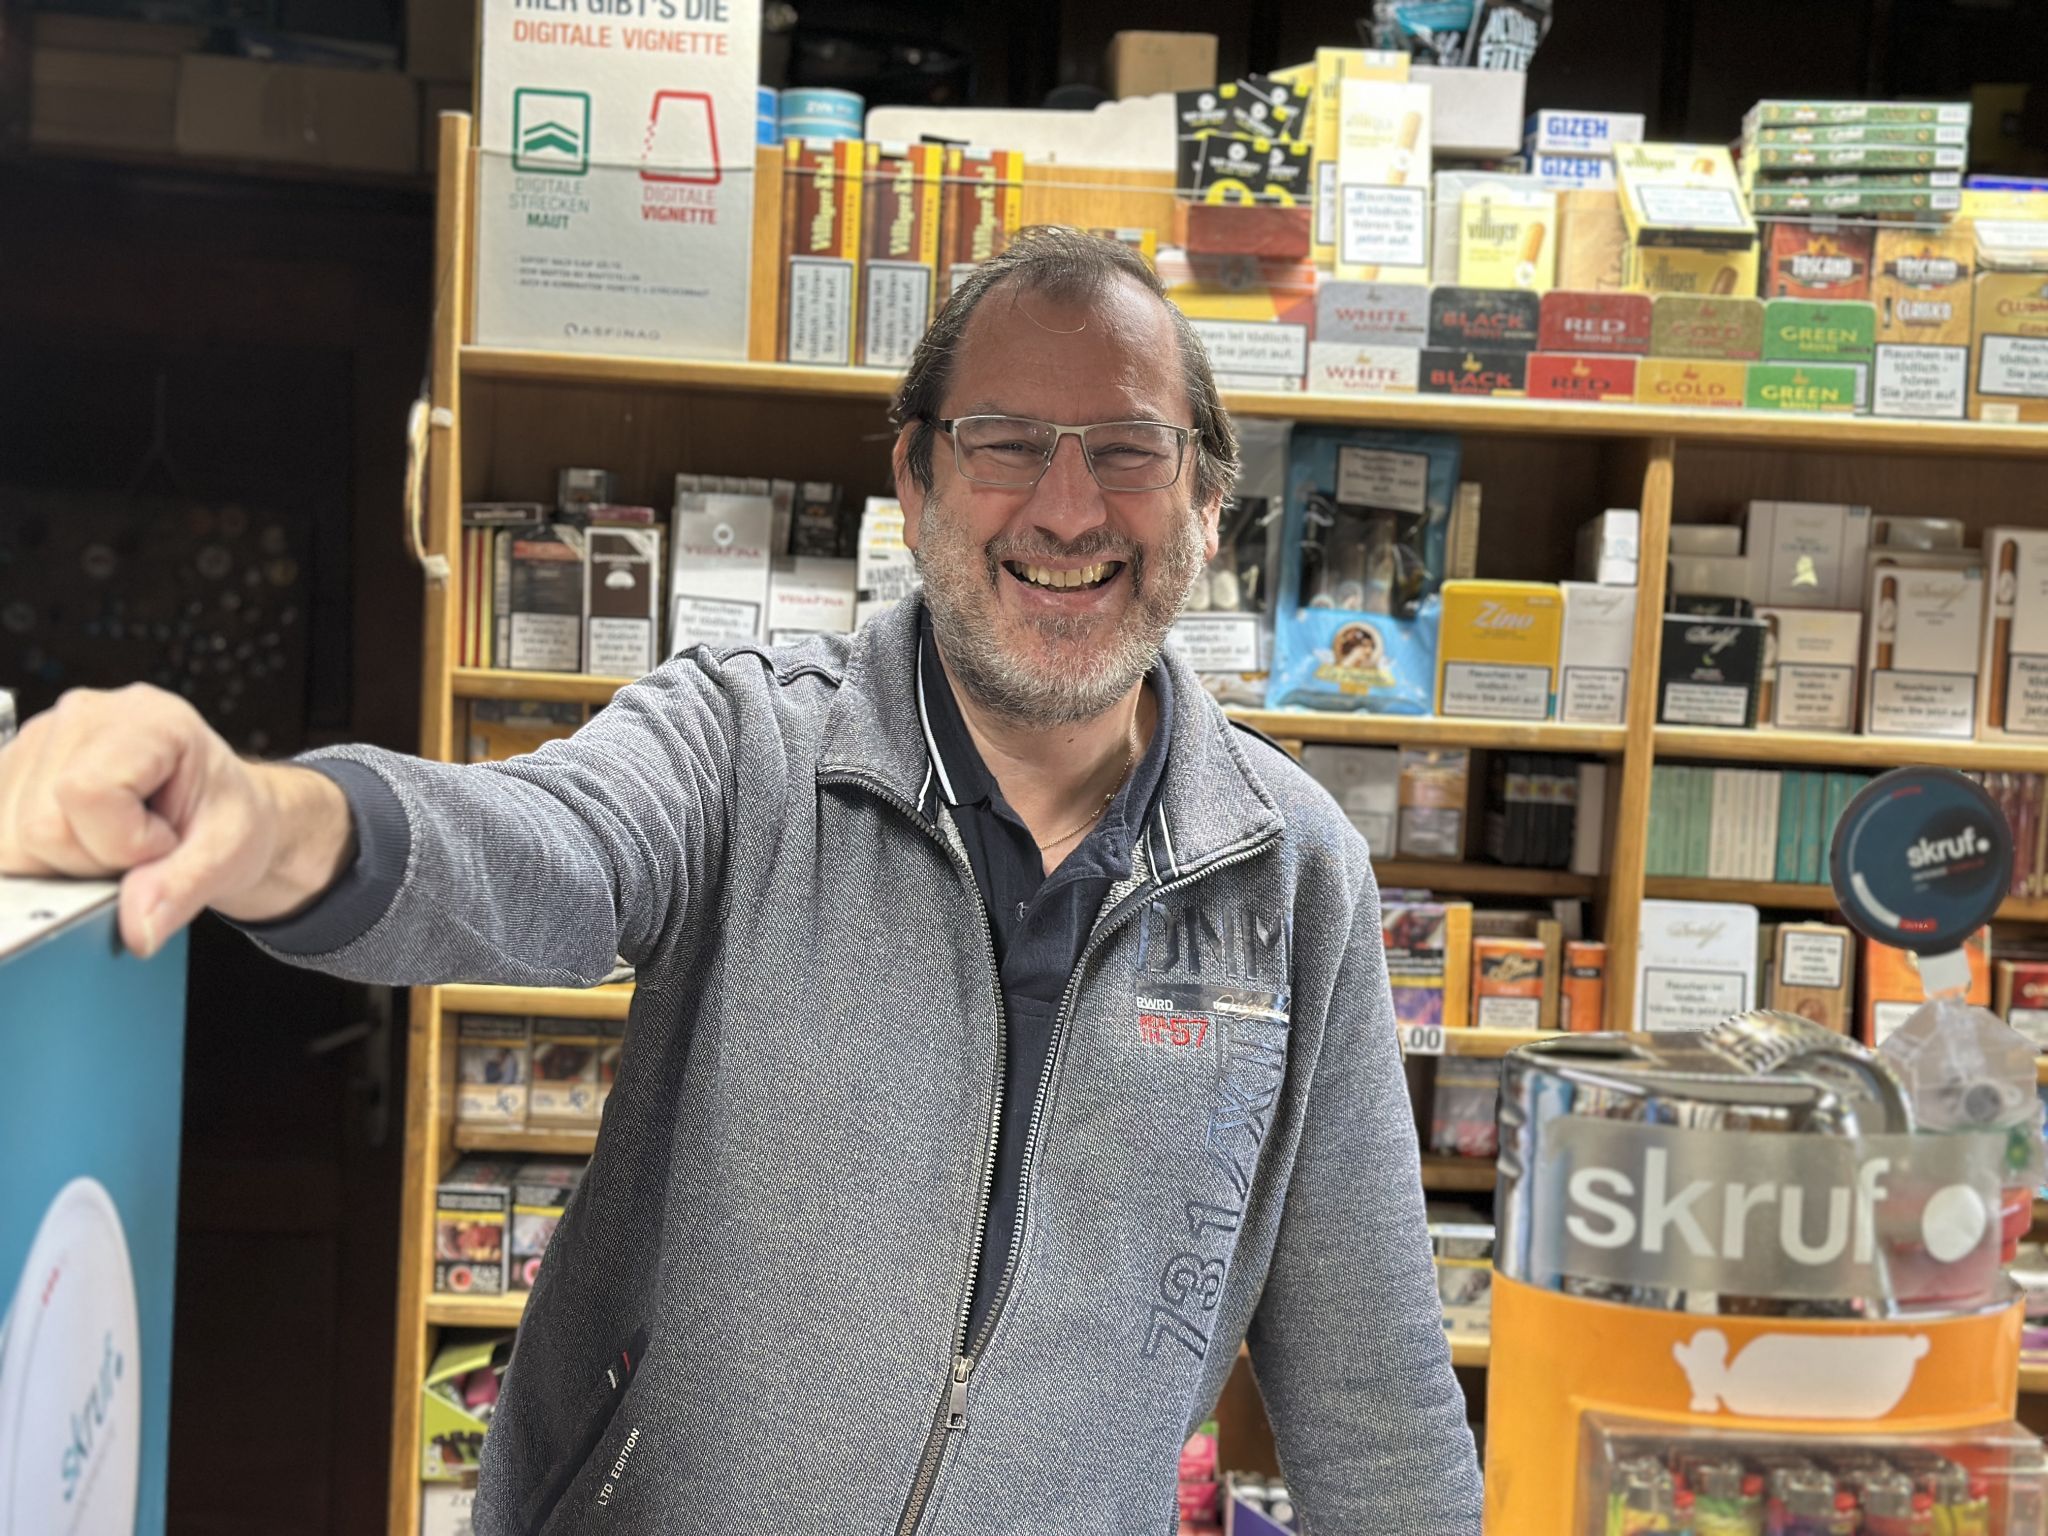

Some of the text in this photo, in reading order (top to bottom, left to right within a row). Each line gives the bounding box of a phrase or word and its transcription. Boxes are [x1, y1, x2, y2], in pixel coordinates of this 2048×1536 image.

[588, 0, 677, 19] GIBTS
[685, 0, 729, 22] DIE
[513, 19, 729, 56] DIGITALE VIGNETTE
[1547, 116, 1608, 138] GIZEH
[1540, 156, 1601, 178] GIZEH
[515, 177, 583, 196] DIGITALE
[643, 186, 717, 206] DIGITALE
[509, 194, 590, 213] STRECKEN
[526, 213, 570, 230] MAUT
[641, 204, 717, 225] VIGNETTE
[811, 190, 836, 251] Villiger
[1467, 196, 1519, 247] villiger
[889, 195, 914, 256] Villiger
[1792, 255, 1854, 277] TOSCANO
[1896, 258, 1957, 280] TOSCANO
[1335, 308, 1408, 322] WHITE
[1442, 311, 1525, 329] BLACK
[1564, 317, 1627, 333] RED
[1671, 321, 1743, 339] GOLD
[1780, 325, 1857, 343] GREEN
[1883, 349, 1940, 360] Rauchen
[1325, 366, 1399, 381] WHITE
[1430, 368, 1512, 388] BLACK
[1552, 377, 1611, 390] RED
[1655, 381, 1726, 397] GOLD
[1760, 384, 1840, 401] GREEN
[1473, 601, 1536, 630] Zino
[1906, 826, 1976, 868] skruf
[1565, 1147, 1890, 1264] skruf
[598, 1428, 640, 1506] LTD EDITION
